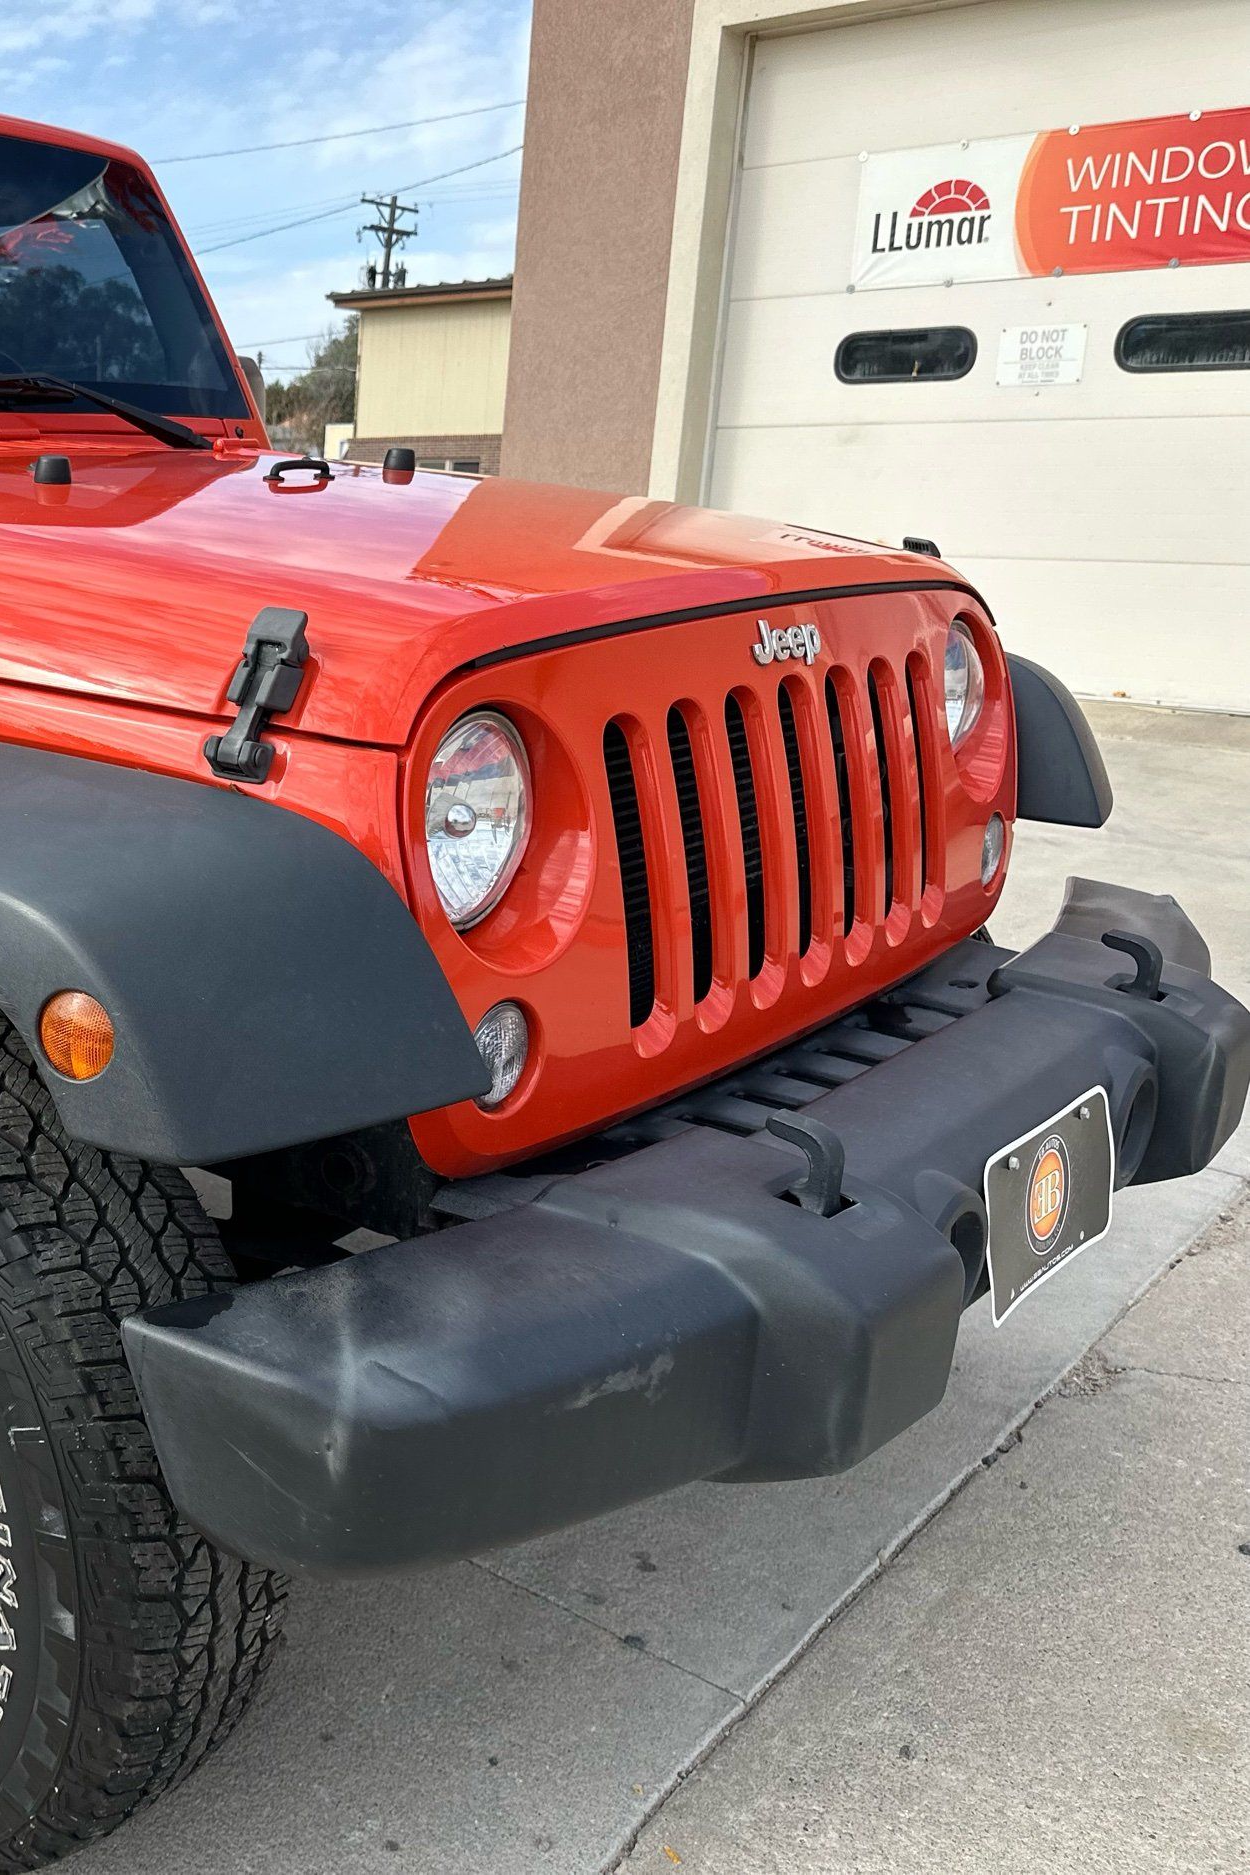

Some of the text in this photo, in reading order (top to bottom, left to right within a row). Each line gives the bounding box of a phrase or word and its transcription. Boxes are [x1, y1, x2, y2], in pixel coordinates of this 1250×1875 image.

[1066, 138, 1250, 193] WINDO
[871, 211, 991, 254] LLumar
[1020, 328, 1068, 344] DO NOT
[1020, 345, 1063, 360] BLOCK
[752, 619, 821, 665] Jeep
